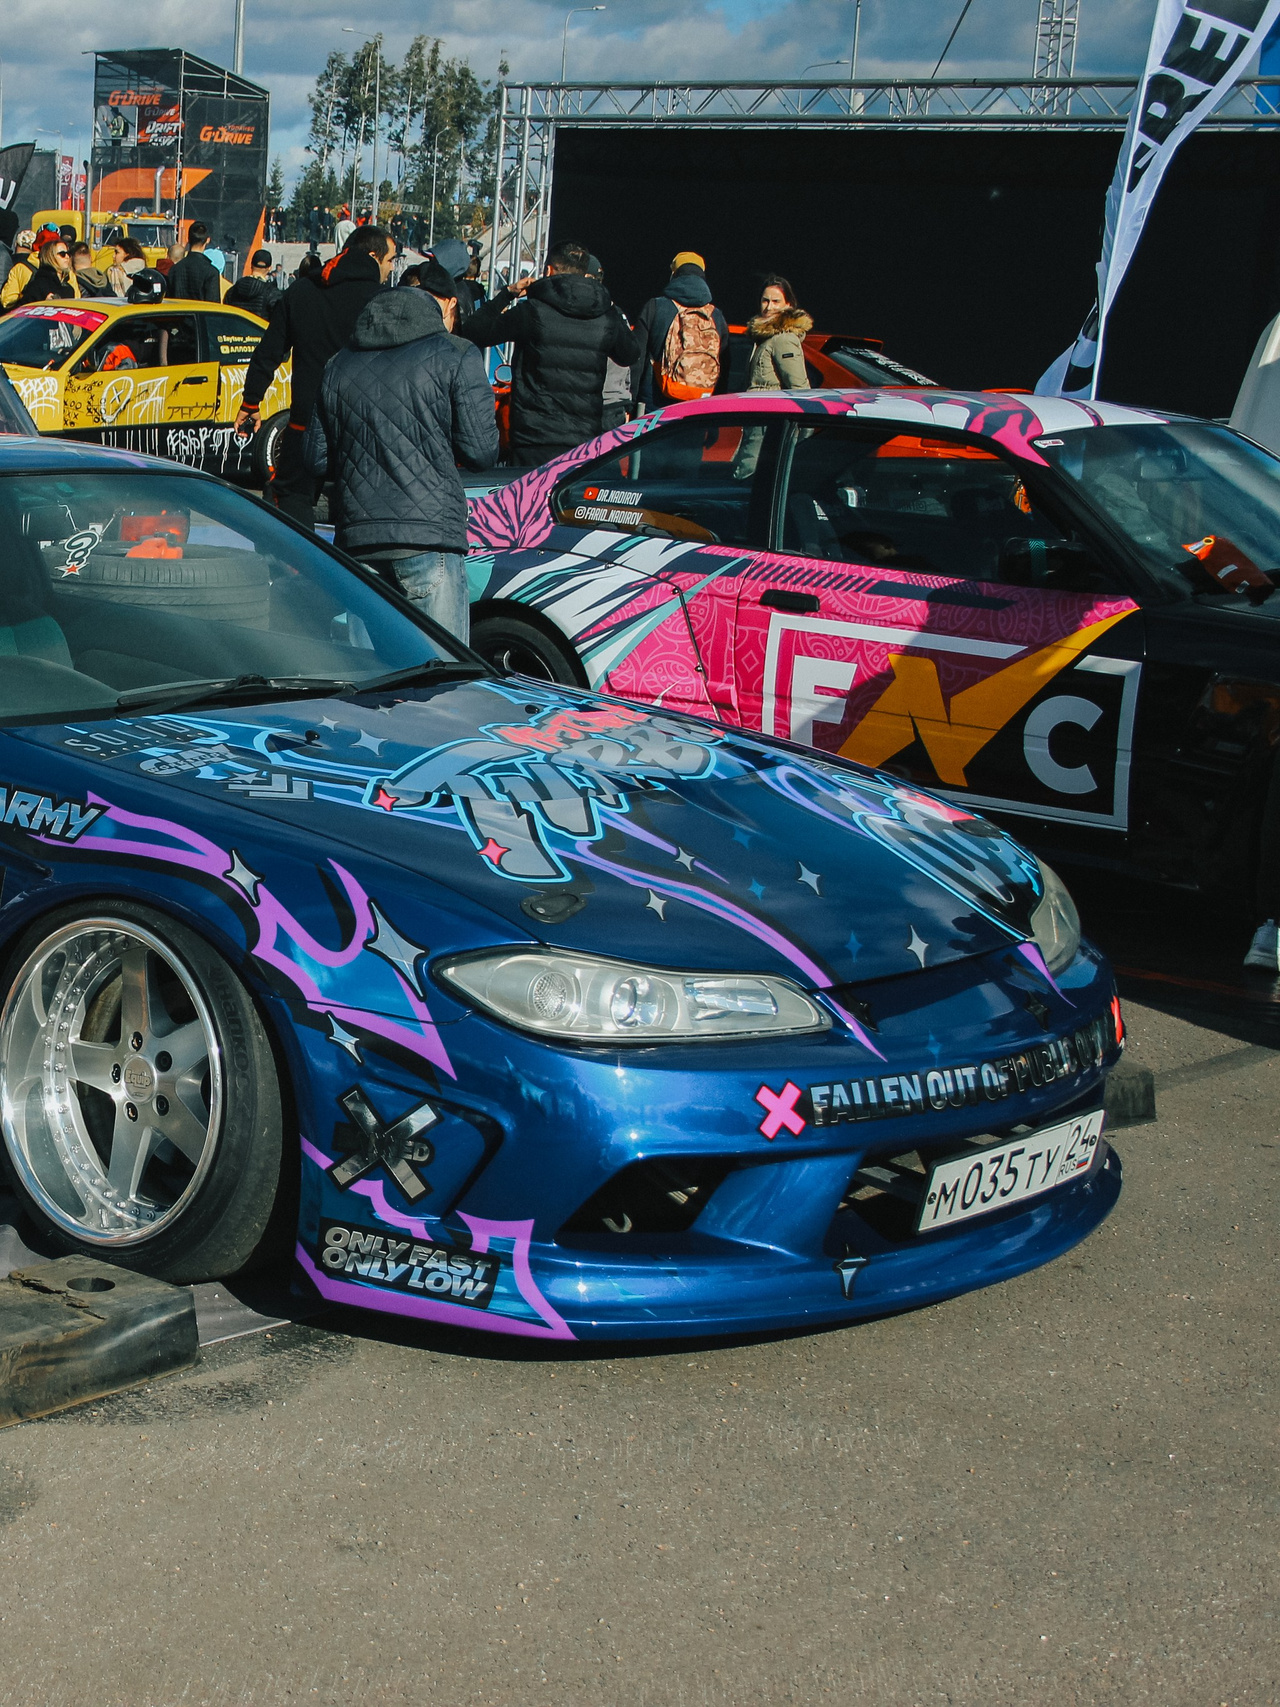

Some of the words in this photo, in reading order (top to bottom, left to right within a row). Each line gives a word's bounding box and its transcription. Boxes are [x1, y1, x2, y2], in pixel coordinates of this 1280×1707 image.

[64, 720, 190, 752] SOLID
[125, 1068, 152, 1089] Equip
[810, 1072, 924, 1126] FALLEN
[925, 1064, 979, 1110] OUT
[980, 1058, 1010, 1101] OF
[1065, 1117, 1093, 1162] 24
[1059, 1160, 1077, 1177] RUS
[322, 1246, 410, 1282] ONLY
[407, 1266, 488, 1300] LOW
[325, 1226, 410, 1261] ONLY
[408, 1245, 492, 1280] FAST
